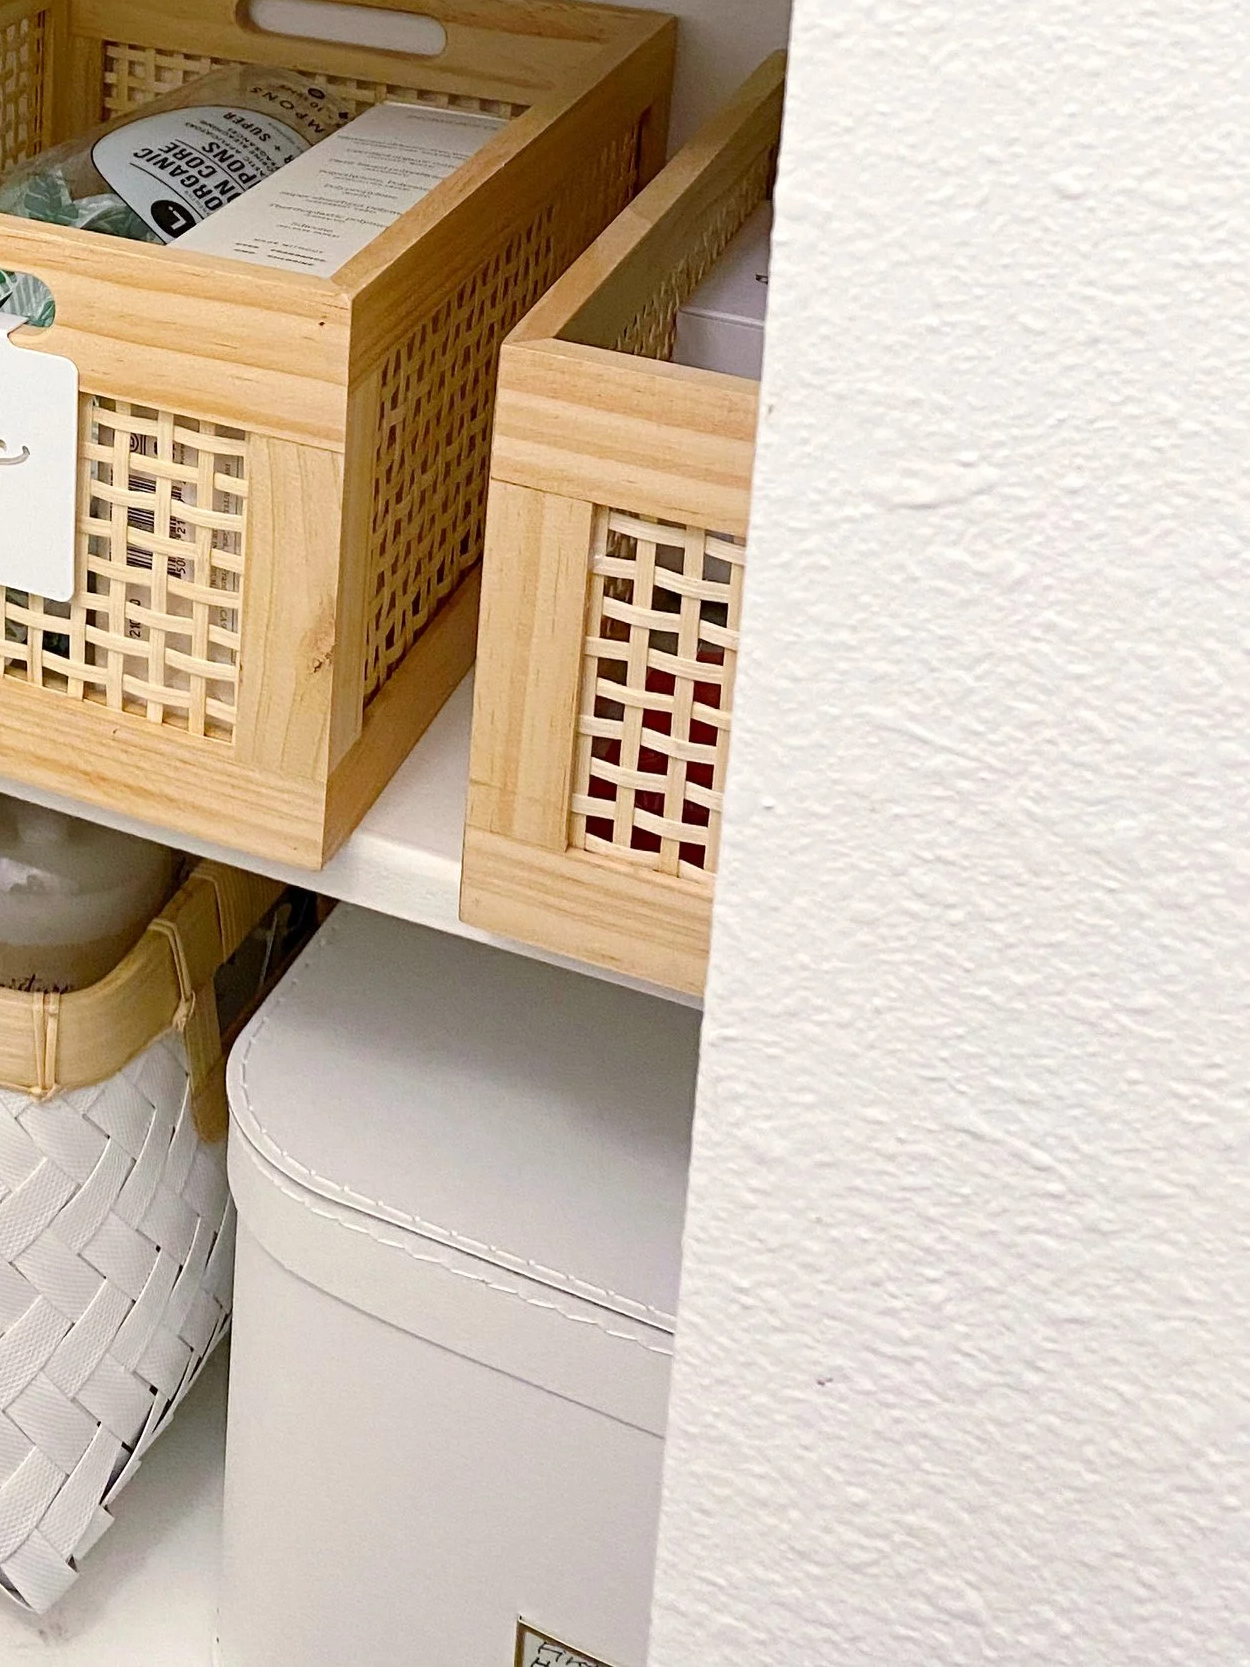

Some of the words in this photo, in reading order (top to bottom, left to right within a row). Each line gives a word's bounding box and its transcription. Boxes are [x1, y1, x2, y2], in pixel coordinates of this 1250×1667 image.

[223, 111, 272, 143] SUPER
[157, 141, 218, 178] CORE
[133, 148, 224, 211] ORGANIC
